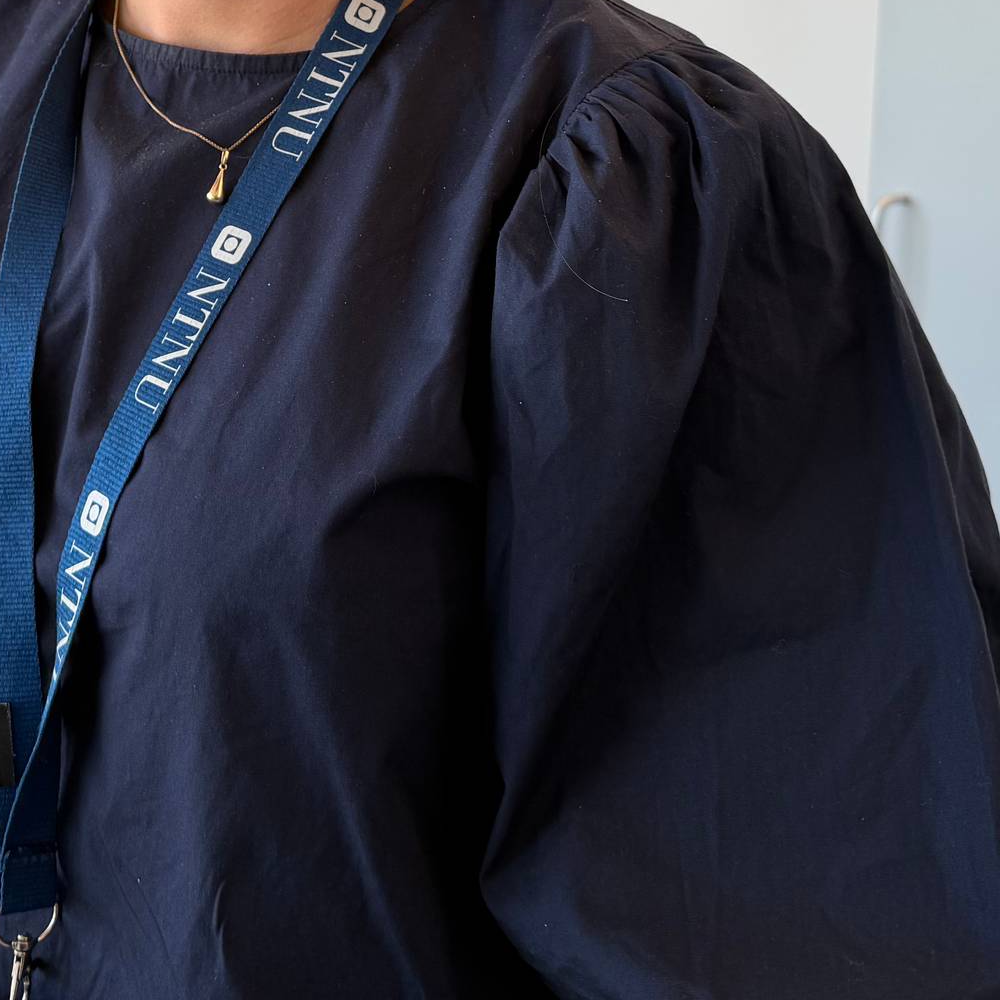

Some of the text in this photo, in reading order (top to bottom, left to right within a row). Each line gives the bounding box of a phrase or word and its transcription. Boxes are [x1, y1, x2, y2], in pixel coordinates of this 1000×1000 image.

[272, 30, 368, 162] NTNU
[135, 267, 231, 415] NTNU
[53, 539, 94, 680] NTN
